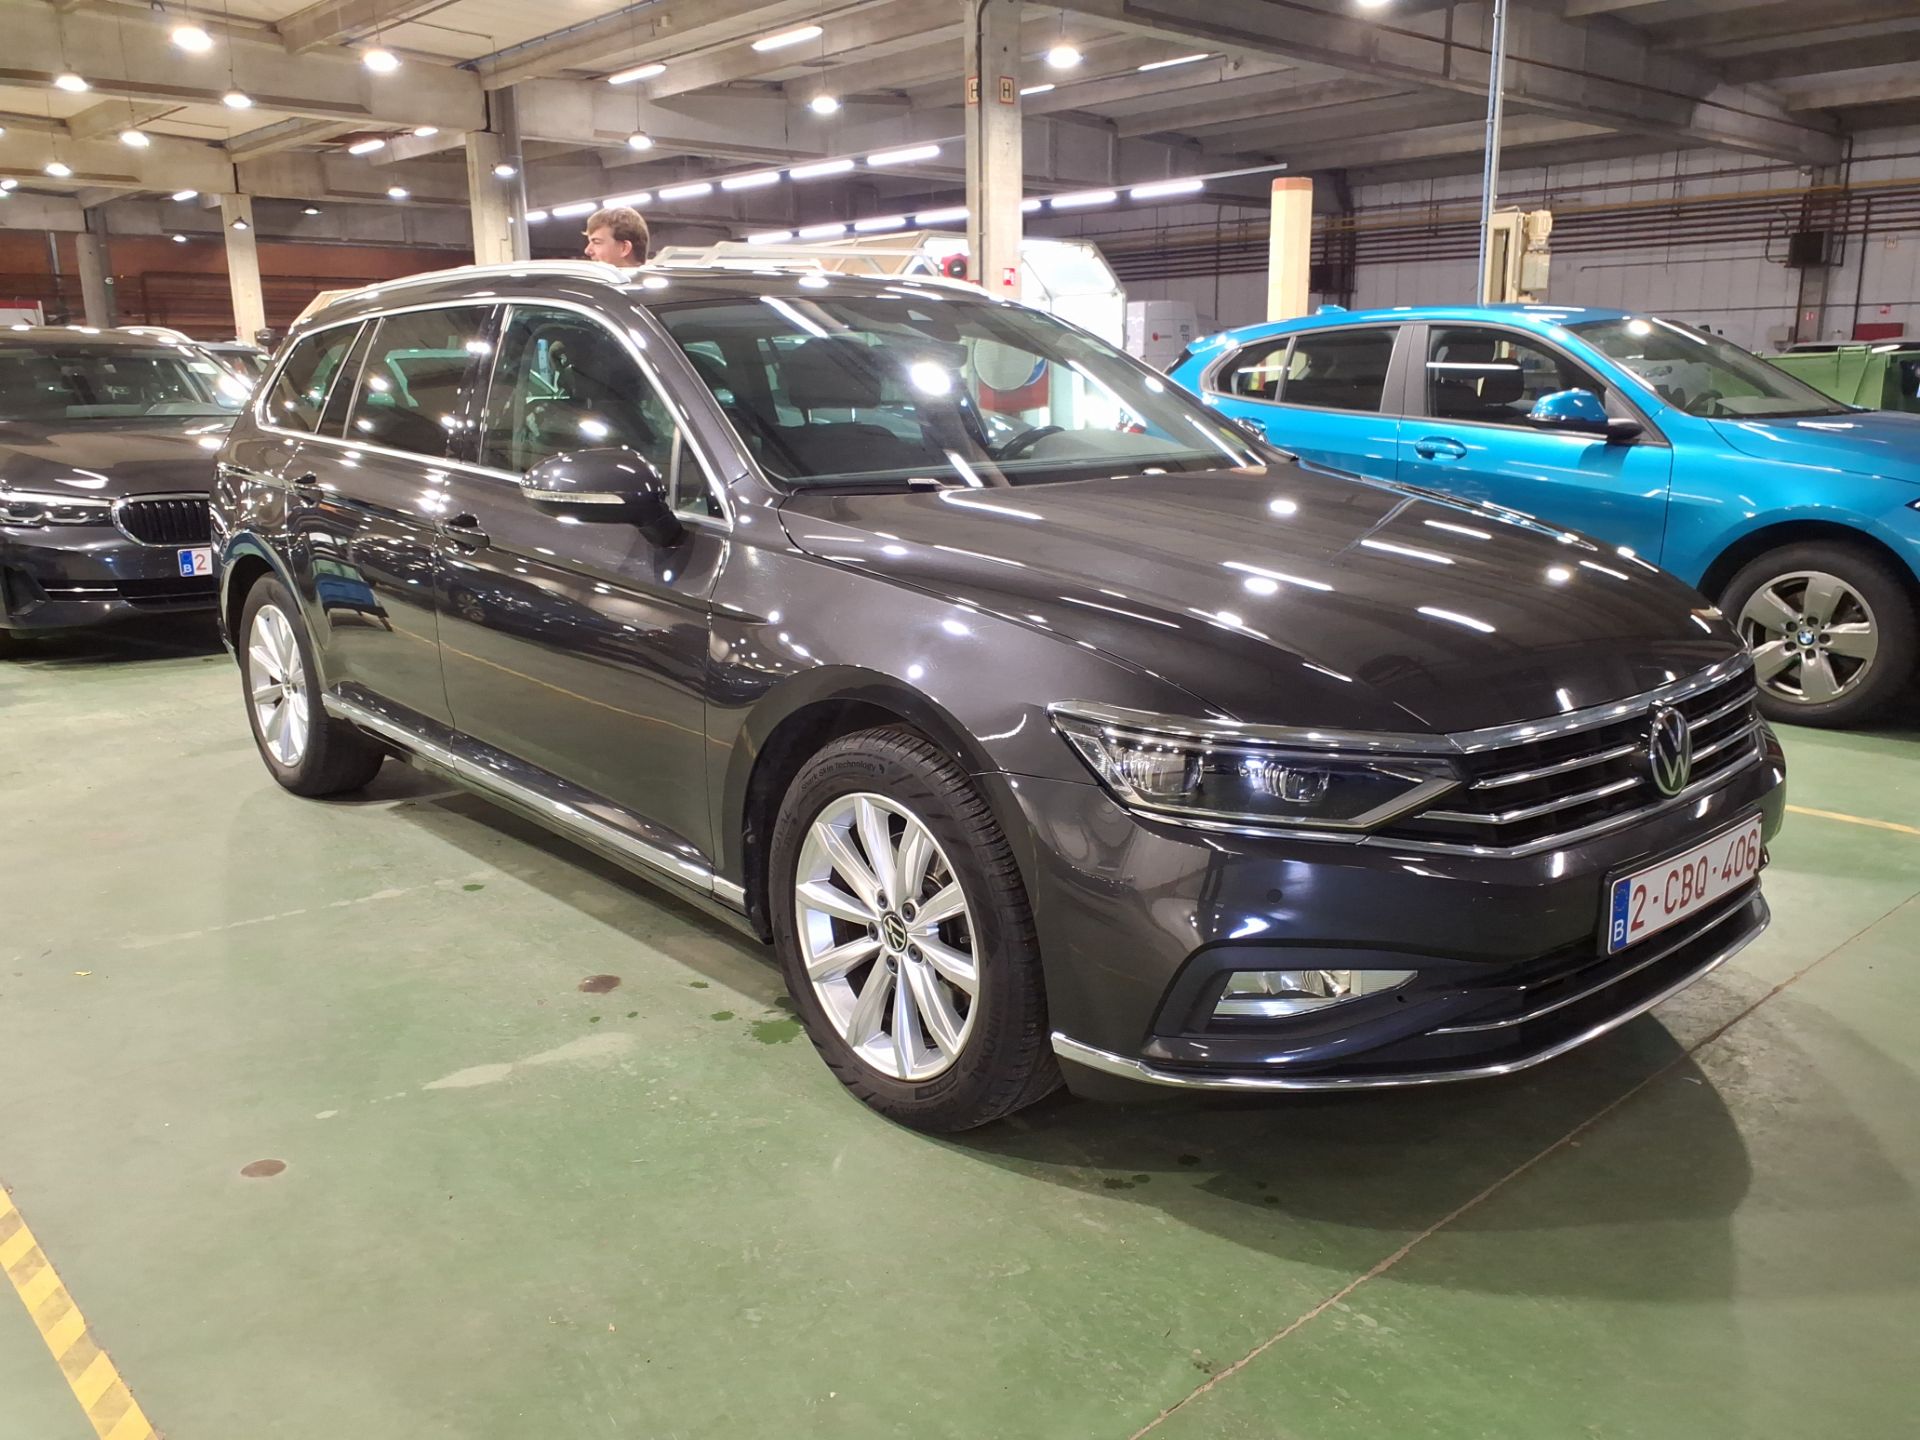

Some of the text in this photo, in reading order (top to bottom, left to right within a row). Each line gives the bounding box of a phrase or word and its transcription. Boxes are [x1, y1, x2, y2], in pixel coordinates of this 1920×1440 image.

[1003, 83, 1011, 98] H
[819, 764, 834, 777] Skin
[835, 759, 877, 772] Technology
[1613, 919, 1625, 942] B
